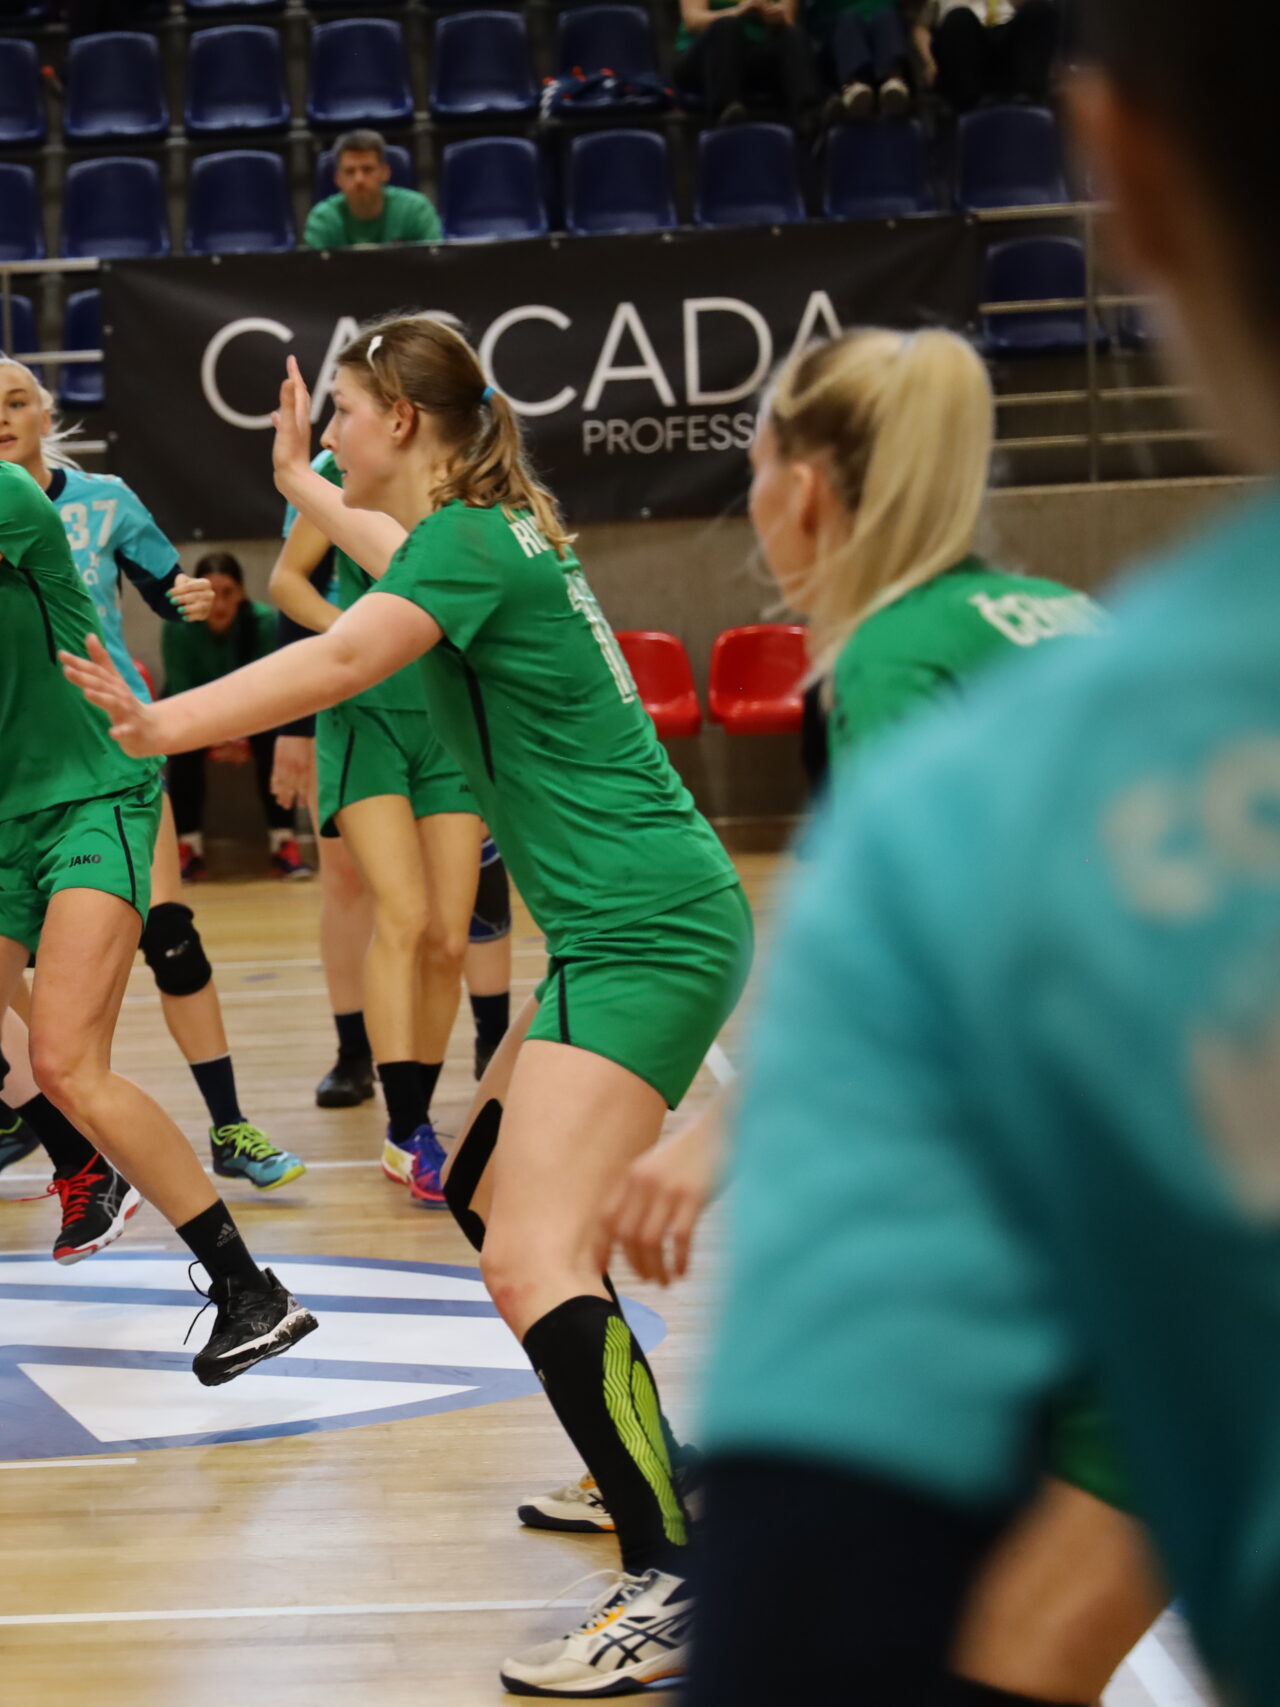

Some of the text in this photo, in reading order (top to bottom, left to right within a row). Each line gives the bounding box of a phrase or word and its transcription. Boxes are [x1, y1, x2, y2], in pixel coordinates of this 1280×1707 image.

[201, 288, 844, 430] CACADA
[582, 412, 757, 455] PROFESS
[60, 498, 118, 550] 37
[69, 854, 102, 868] JAKO
